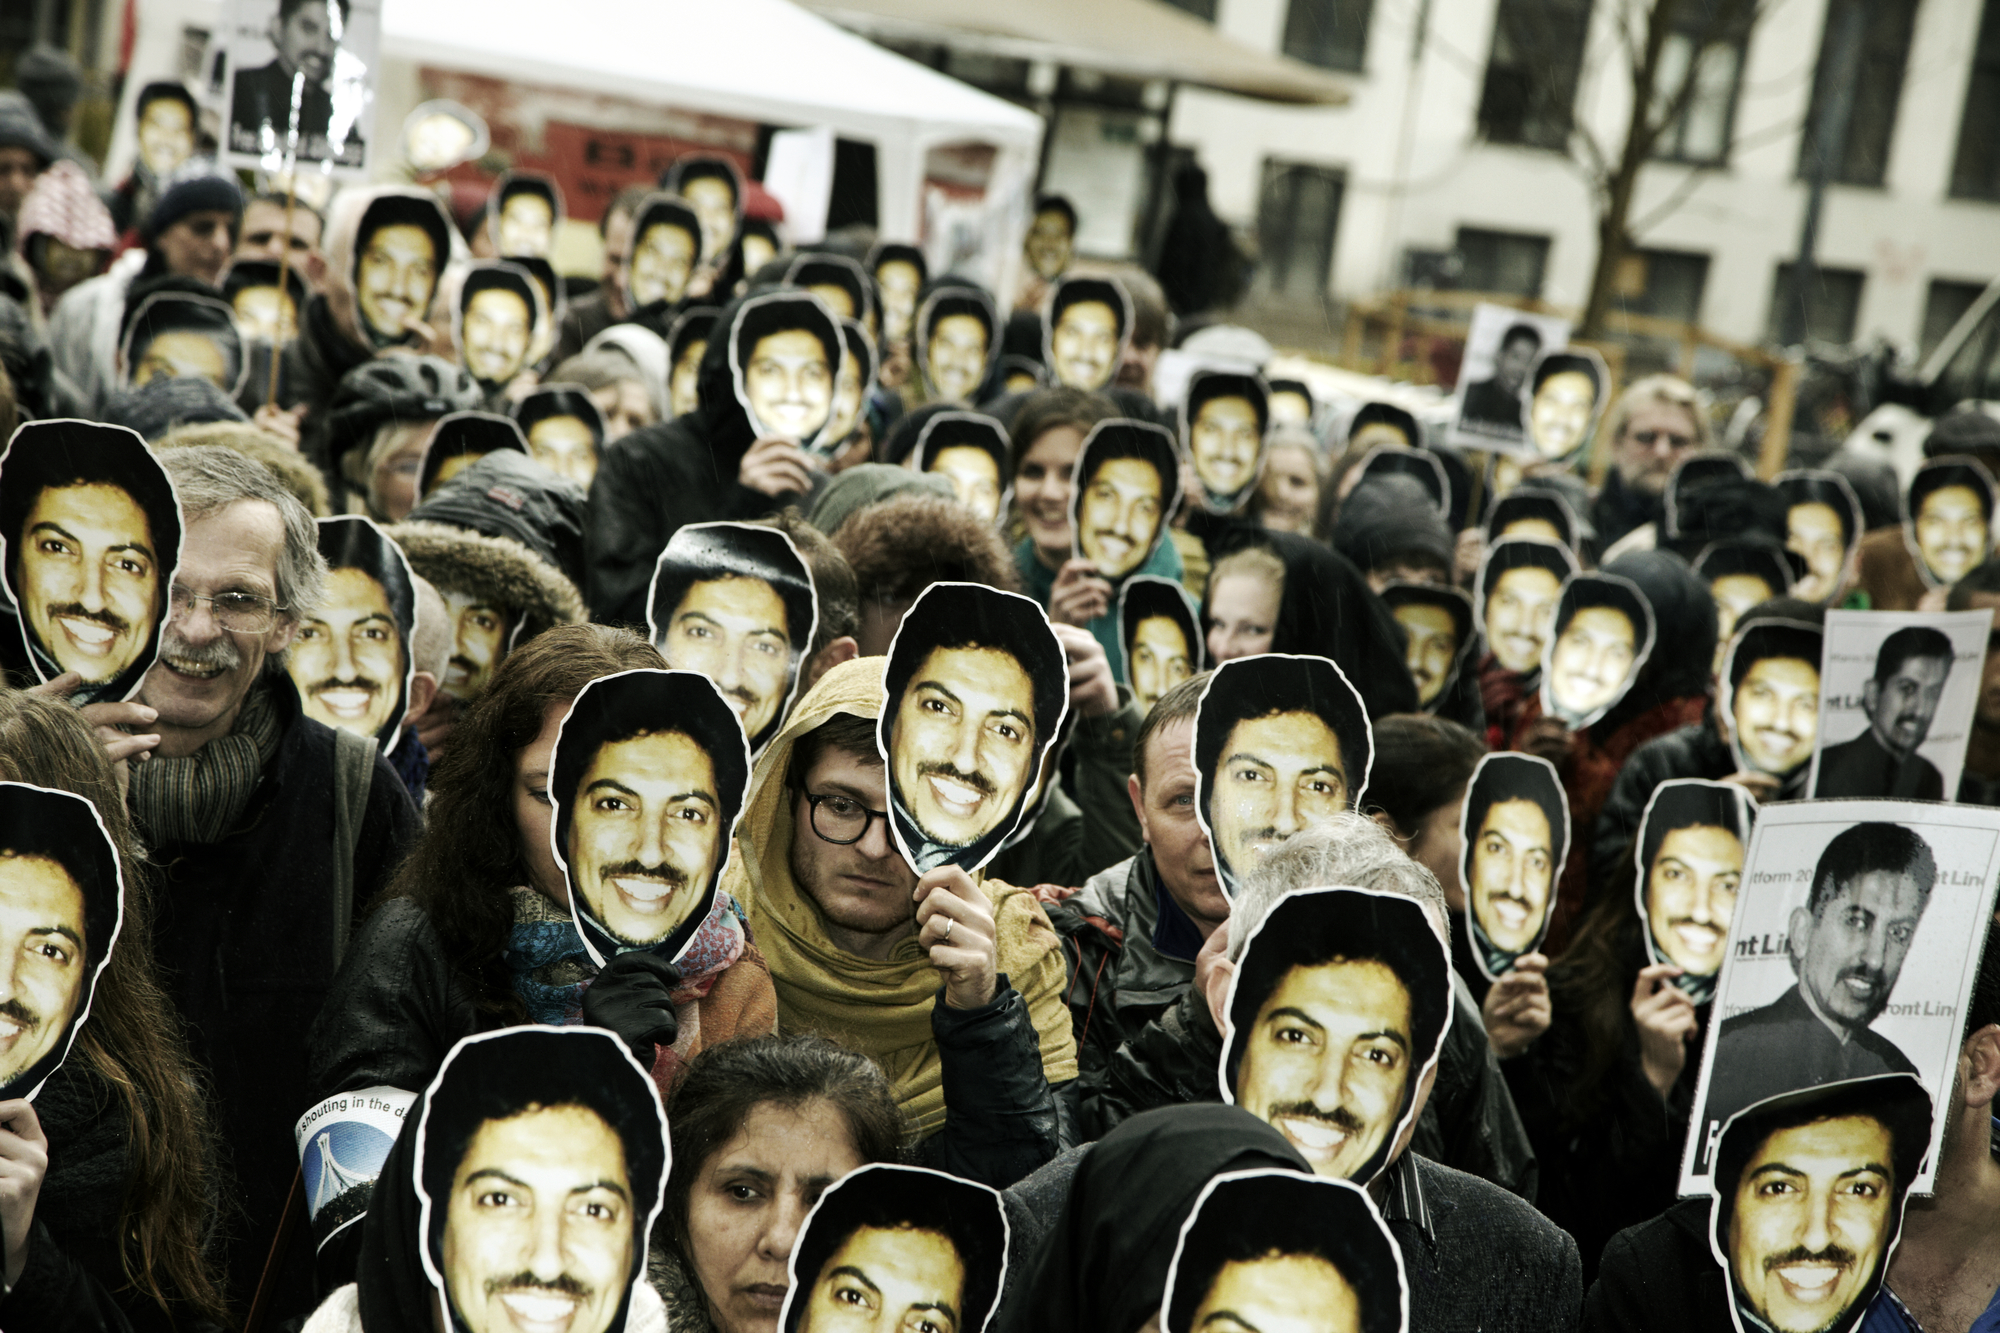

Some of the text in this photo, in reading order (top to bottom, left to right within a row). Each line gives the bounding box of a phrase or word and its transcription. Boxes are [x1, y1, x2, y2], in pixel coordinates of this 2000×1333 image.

[302, 1098, 348, 1132] shouting
[352, 1096, 365, 1109] in
[369, 1097, 391, 1112] the
